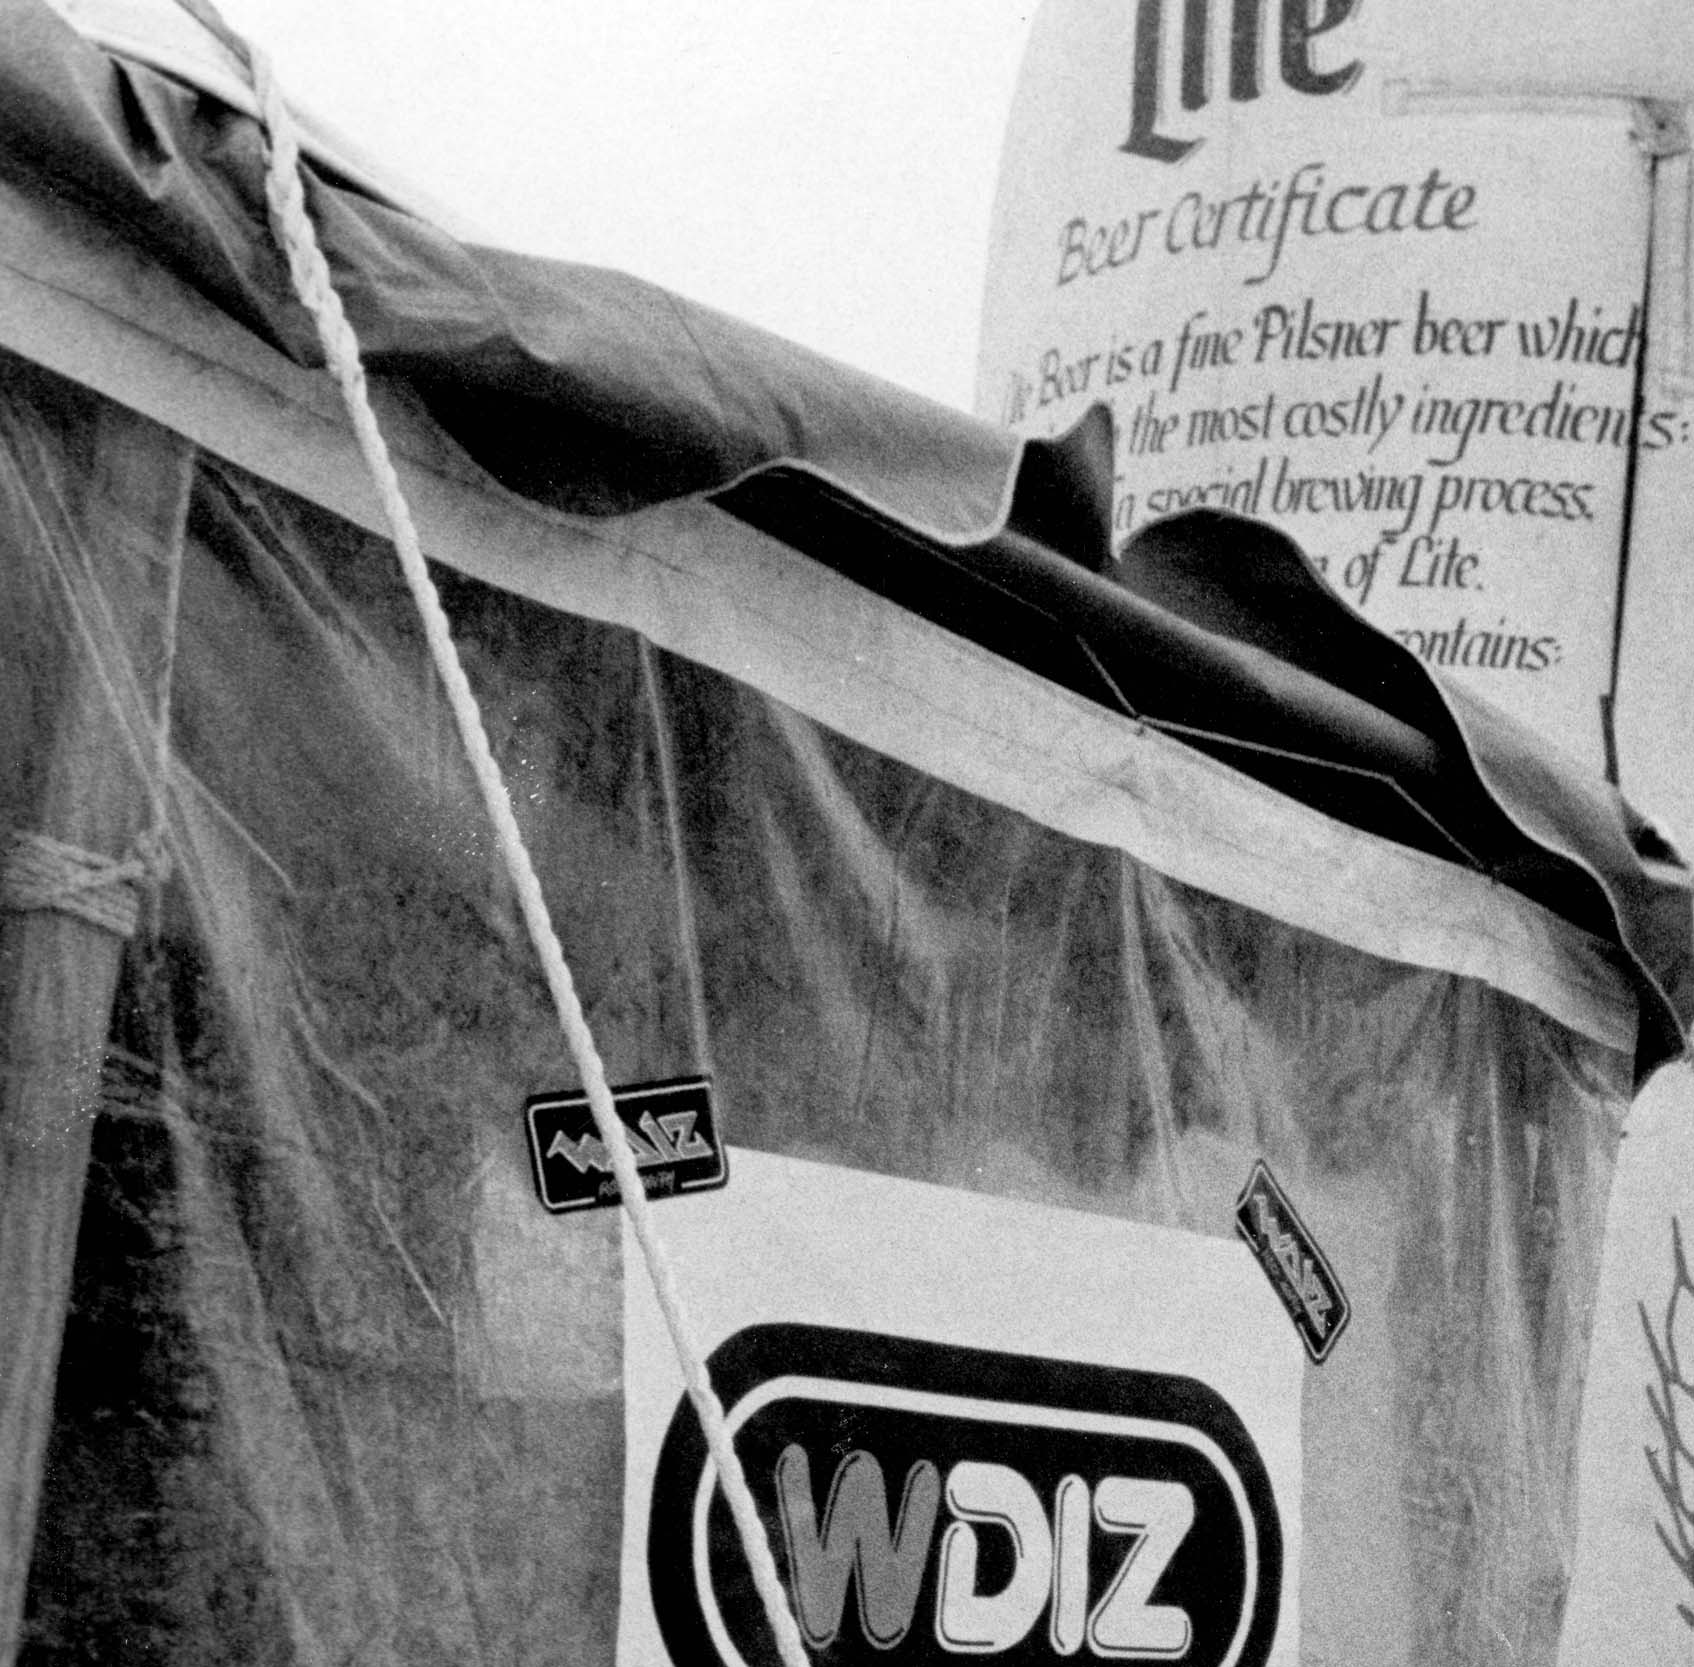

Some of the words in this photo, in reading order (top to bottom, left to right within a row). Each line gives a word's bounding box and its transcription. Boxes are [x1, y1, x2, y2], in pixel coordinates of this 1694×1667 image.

[1056, 203, 1161, 288] Beer
[1166, 162, 1480, 286] Certificate
[1139, 339, 1165, 377] a
[1168, 309, 1244, 394] fine
[1254, 298, 1400, 364] Pilsner
[1411, 289, 1509, 357] beer
[1516, 296, 1646, 368] which
[1130, 389, 1181, 455] the
[1187, 393, 1276, 447] most
[1283, 372, 1406, 456] costly
[1409, 379, 1690, 467] ingrediens:
[1271, 456, 1424, 537] brewing
[1343, 535, 1399, 607] of
[776, 1442, 1195, 1660] WDIZ
